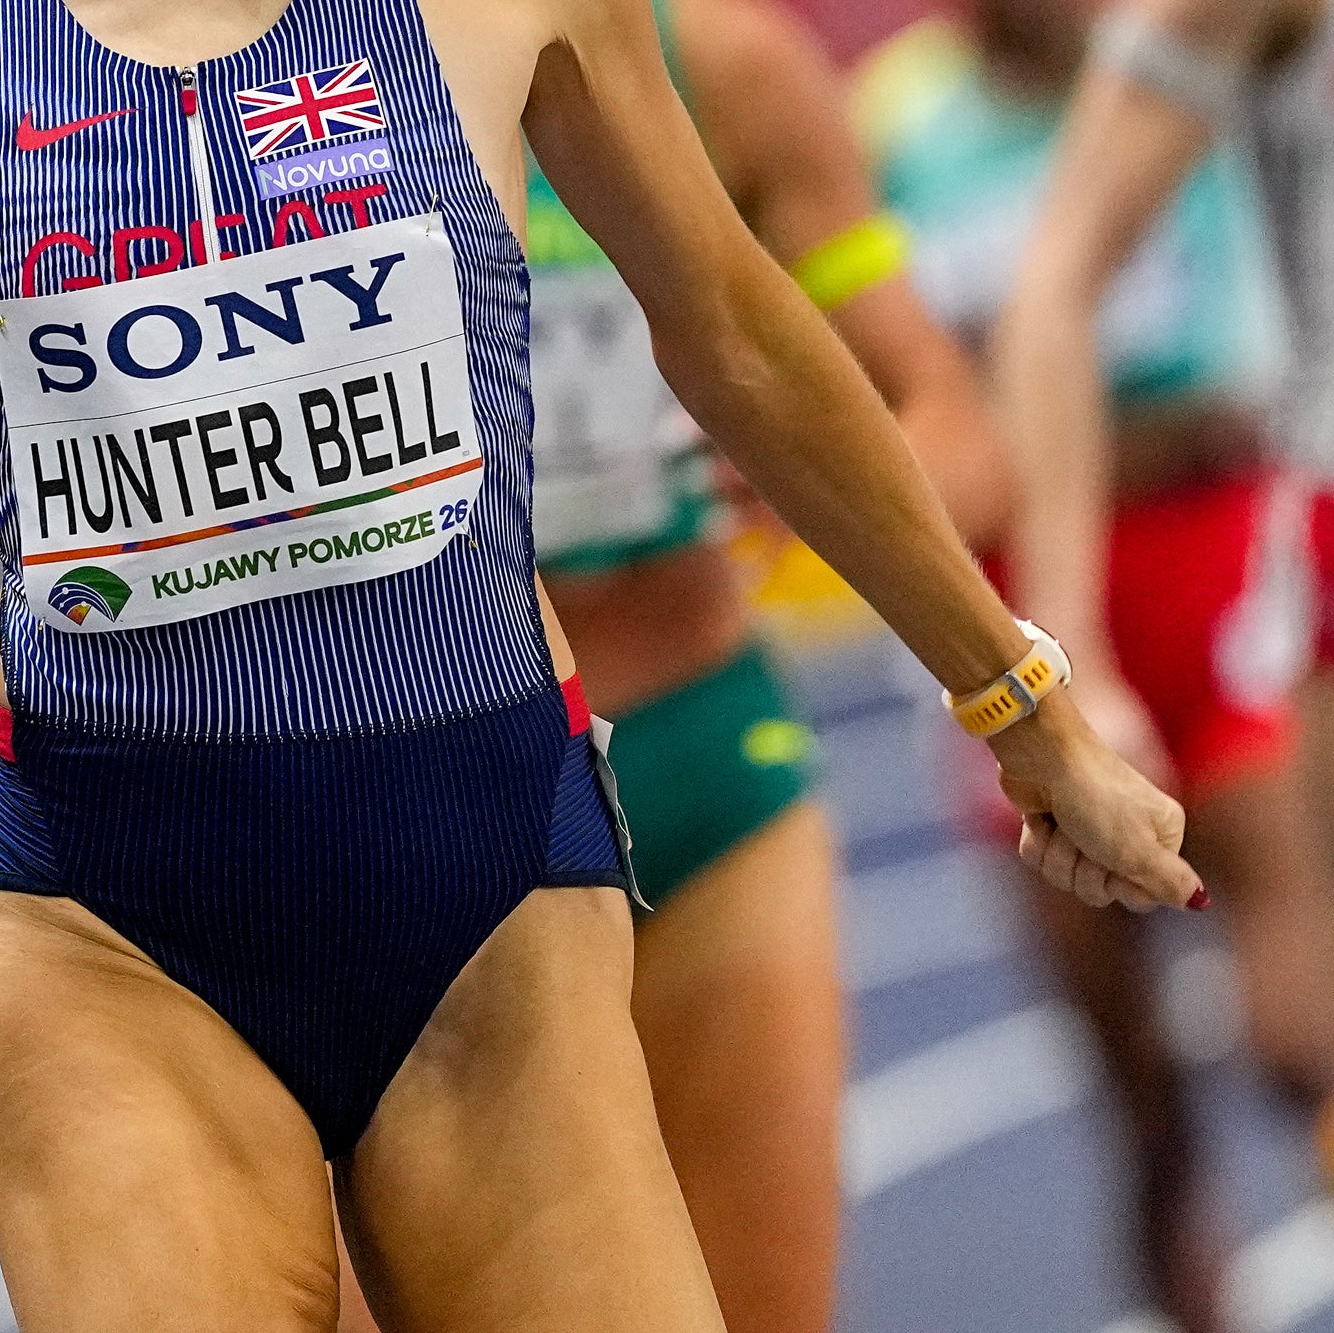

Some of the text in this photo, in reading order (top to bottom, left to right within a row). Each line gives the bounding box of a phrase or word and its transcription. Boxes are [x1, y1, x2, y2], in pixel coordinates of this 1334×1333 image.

[260, 147, 391, 192] Novuna
[29, 252, 405, 393] SONY
[31, 401, 296, 539] HUNTER
[299, 362, 461, 487] BELL
[151, 499, 468, 599] KUJAWY POMORZE 26
